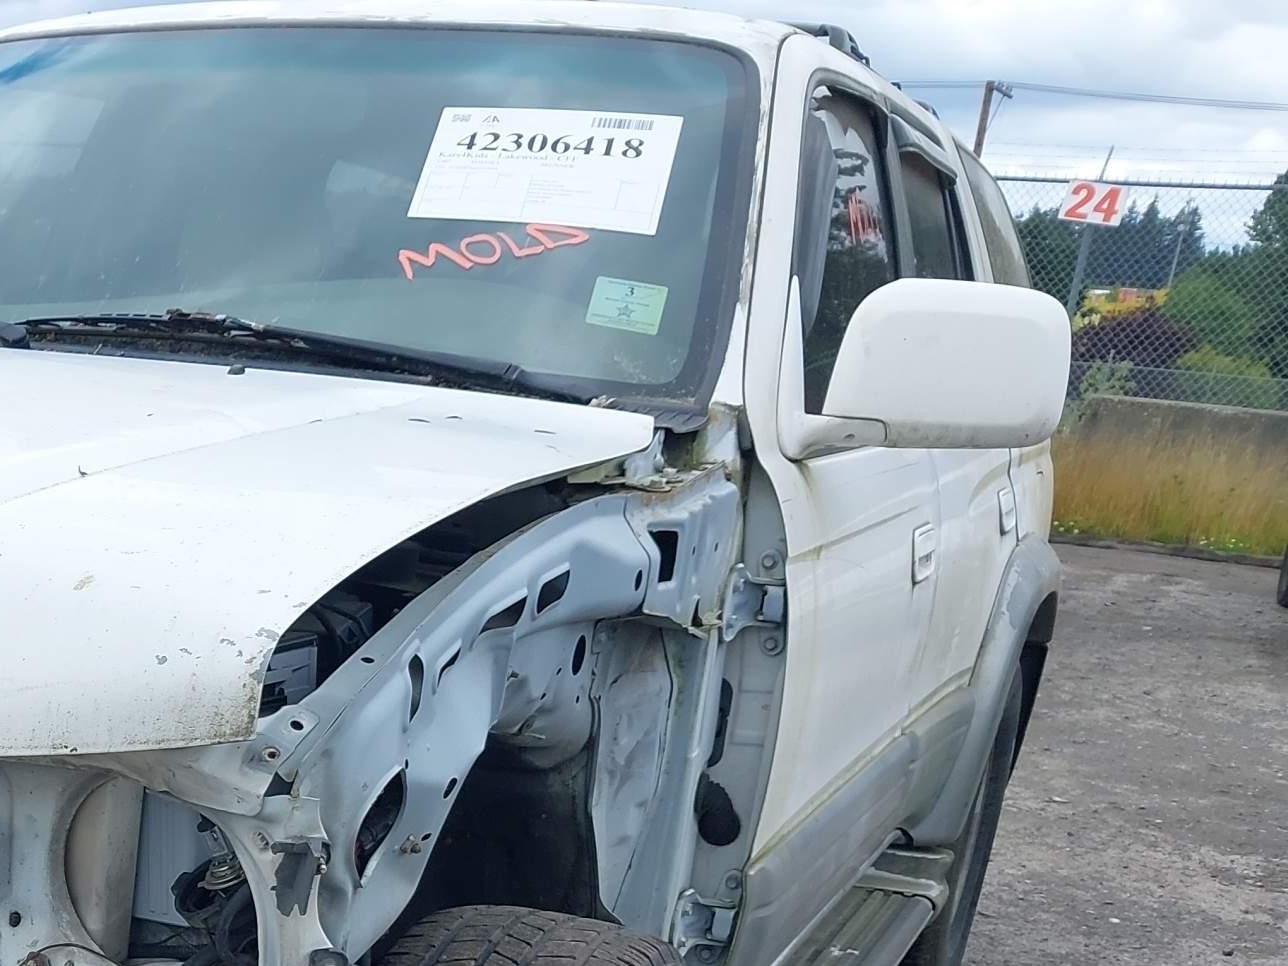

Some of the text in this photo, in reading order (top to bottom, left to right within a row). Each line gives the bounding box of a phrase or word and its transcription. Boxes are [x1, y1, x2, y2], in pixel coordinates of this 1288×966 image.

[456, 131, 645, 160] 42306418
[1064, 183, 1121, 223] 24
[398, 223, 590, 280] MOLD
